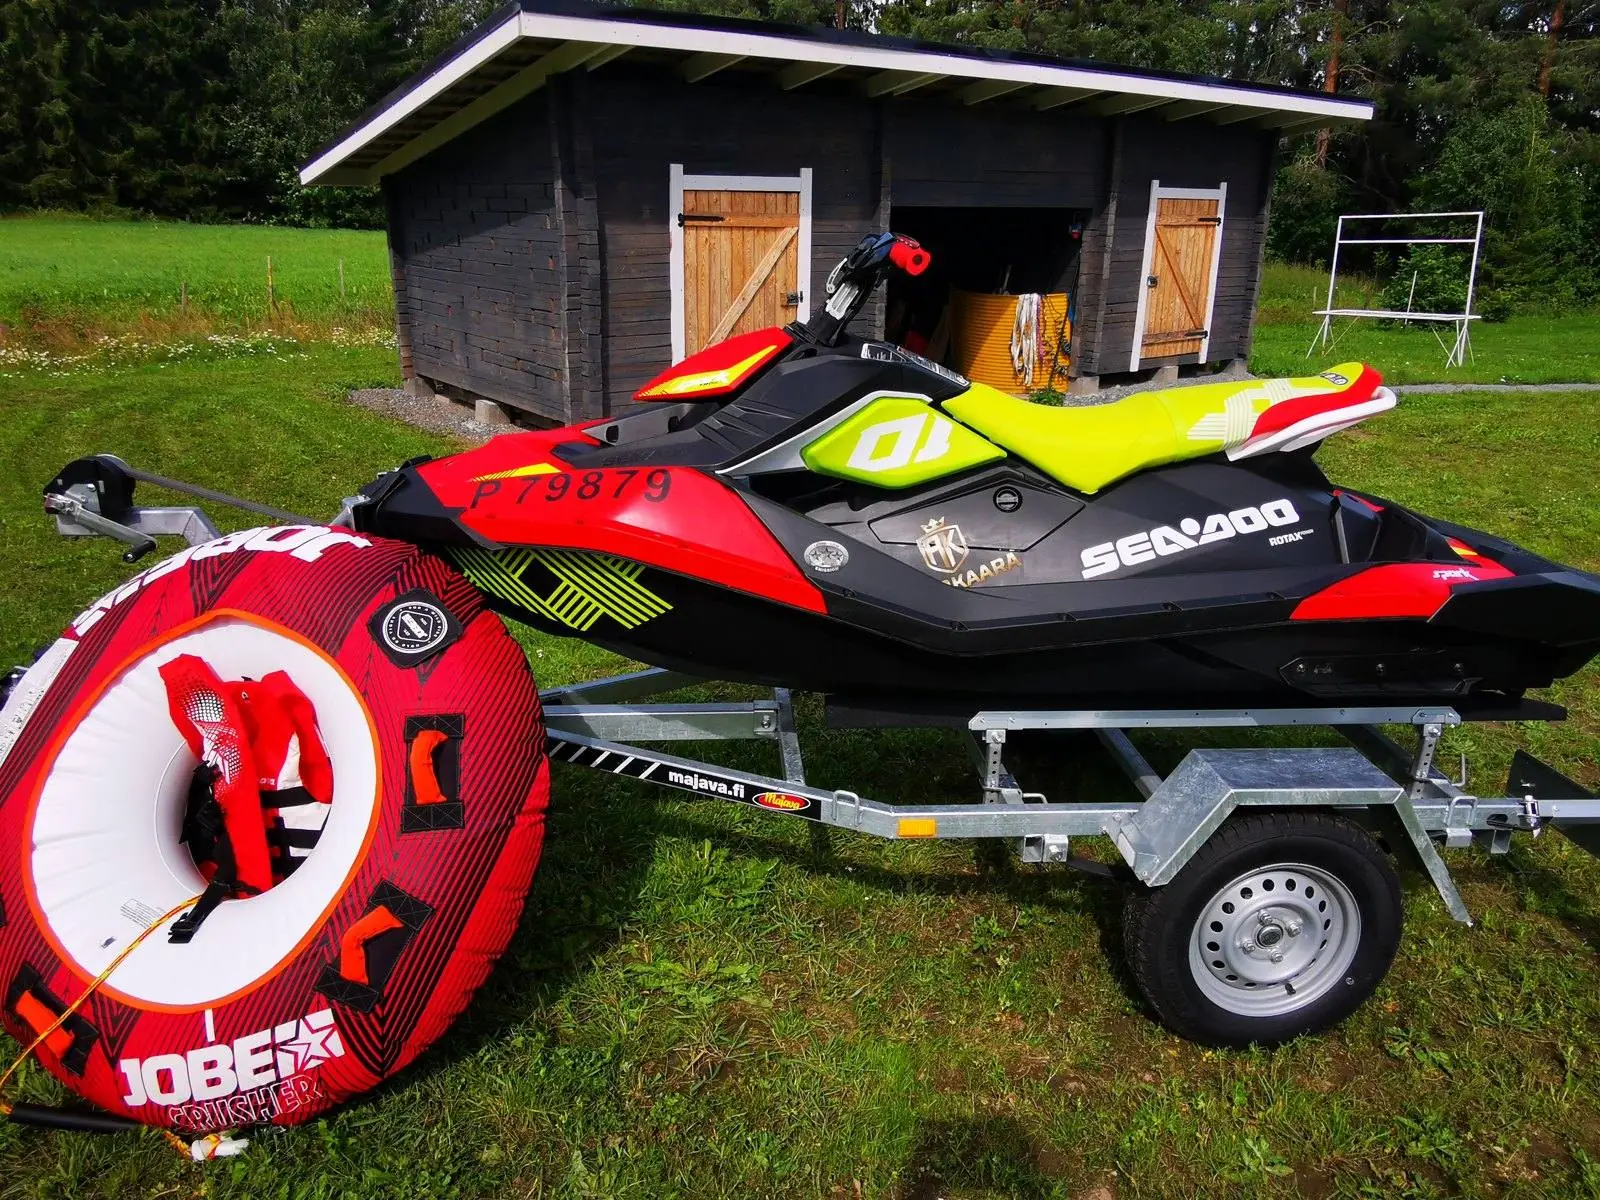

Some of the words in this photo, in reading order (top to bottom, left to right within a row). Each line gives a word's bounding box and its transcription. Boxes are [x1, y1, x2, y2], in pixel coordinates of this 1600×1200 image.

[515, 468, 672, 504] 79879
[1268, 532, 1303, 547] ROTAX
[669, 770, 745, 798] majava.fi
[764, 792, 801, 810] Majava
[120, 1028, 277, 1106] JOBE
